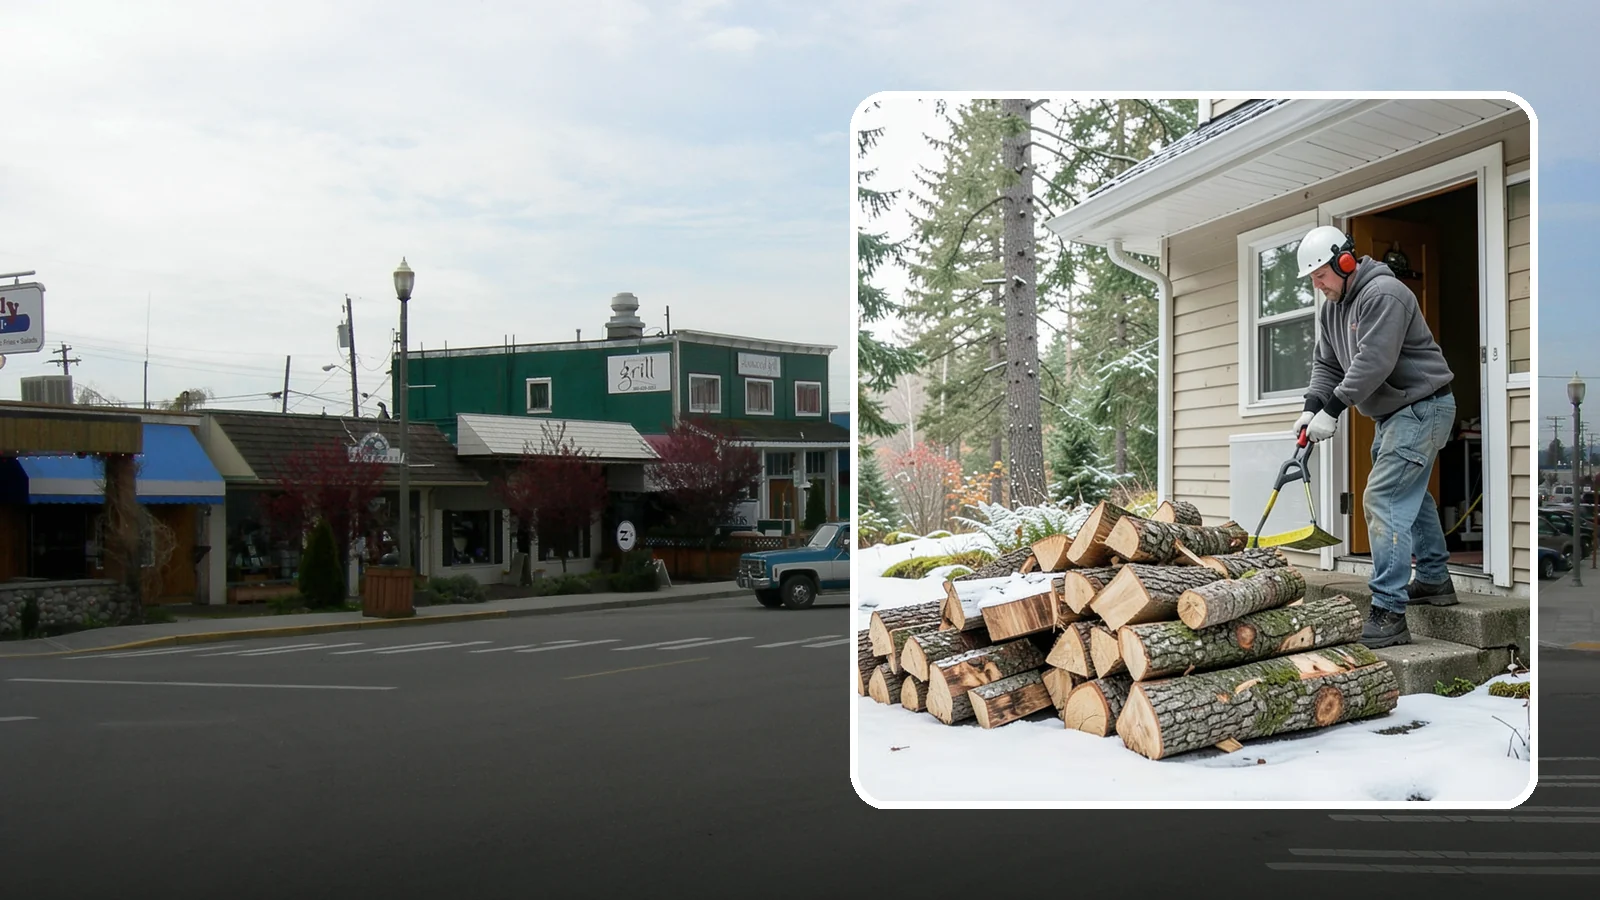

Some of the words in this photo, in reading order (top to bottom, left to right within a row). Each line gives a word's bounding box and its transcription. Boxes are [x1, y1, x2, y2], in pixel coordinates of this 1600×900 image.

[3, 338, 16, 346] Fries
[20, 337, 38, 345] Salads
[617, 355, 655, 391] grill
